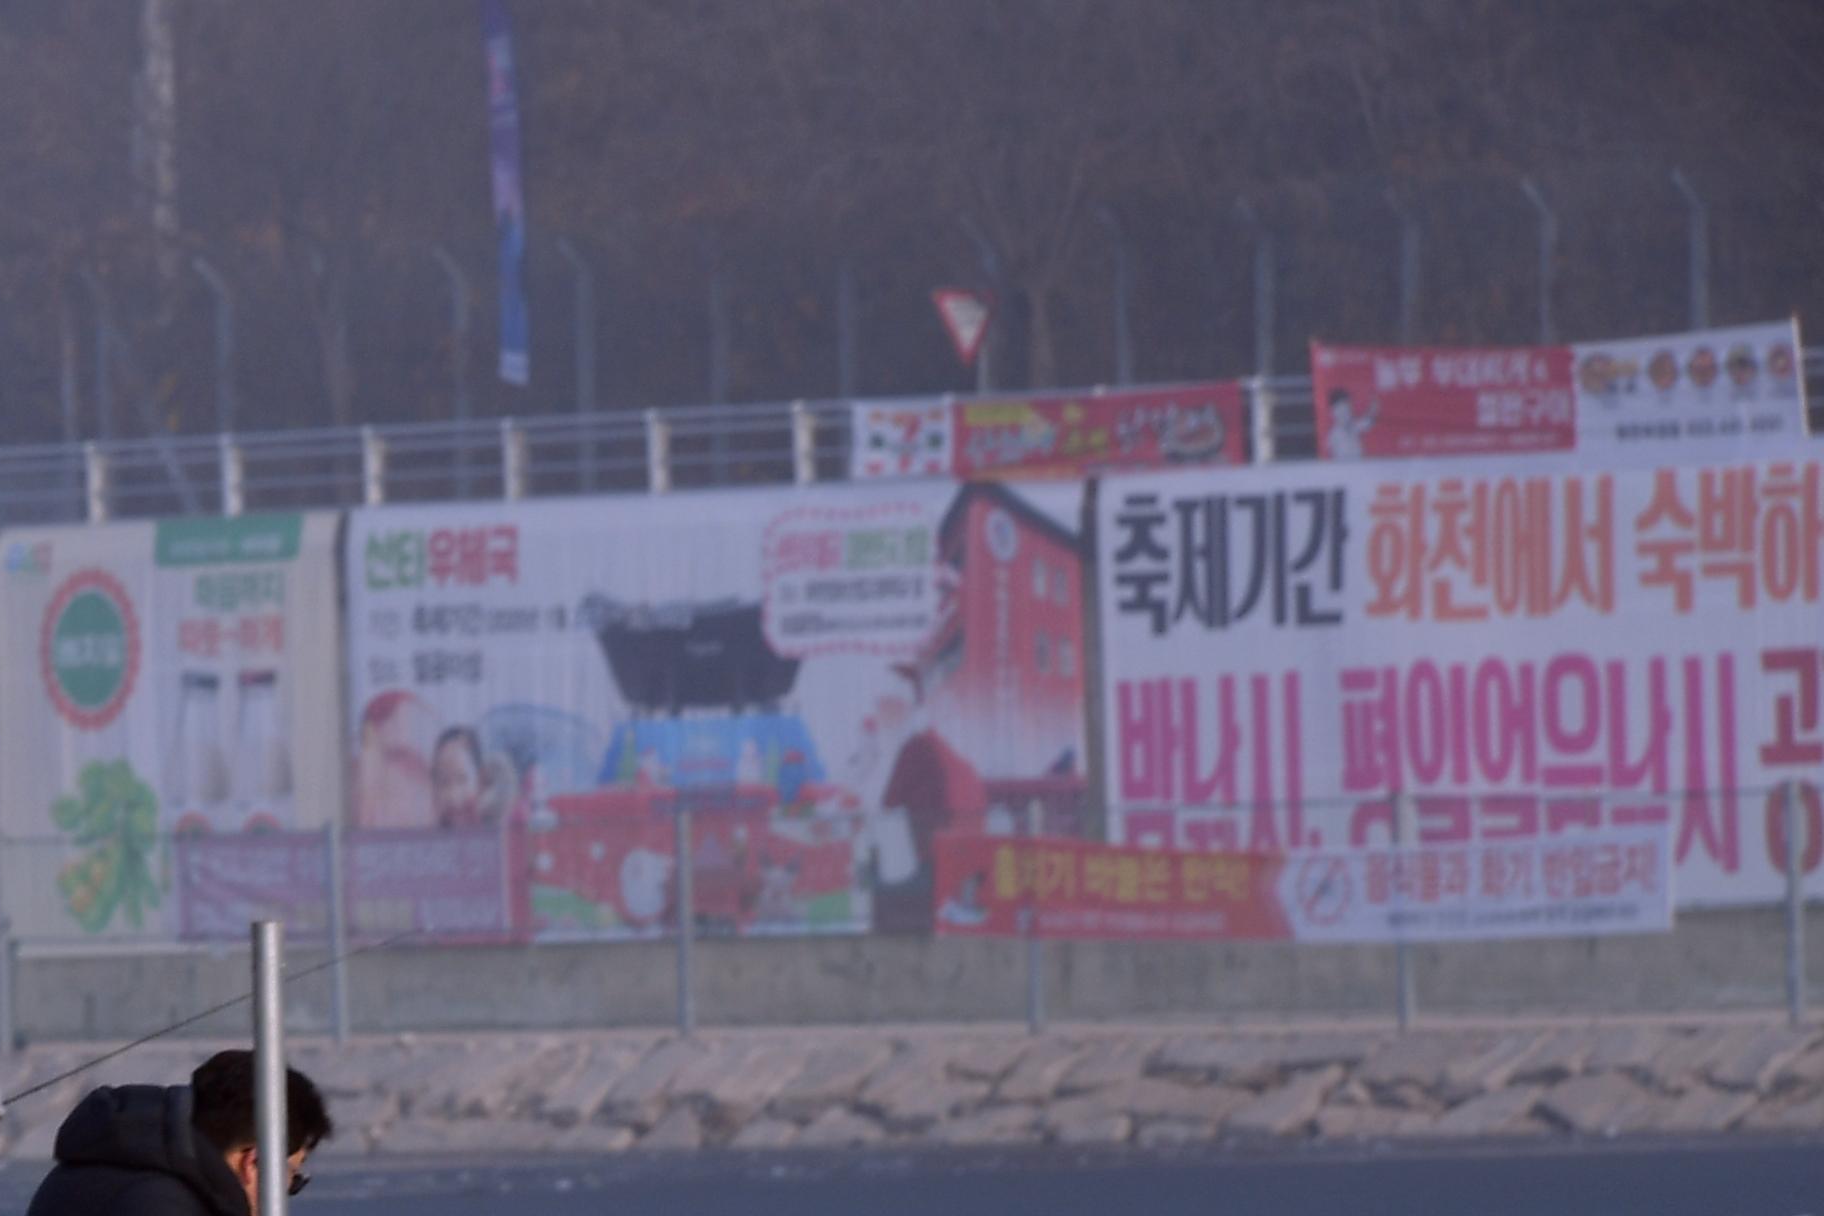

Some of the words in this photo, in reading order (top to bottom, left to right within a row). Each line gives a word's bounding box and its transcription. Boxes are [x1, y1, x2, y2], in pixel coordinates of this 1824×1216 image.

[1114, 488, 1347, 636] 축제기간
[1366, 474, 1614, 622] 화천에서
[1634, 462, 1824, 616] 숙박하
[1759, 646, 1824, 874] 공
